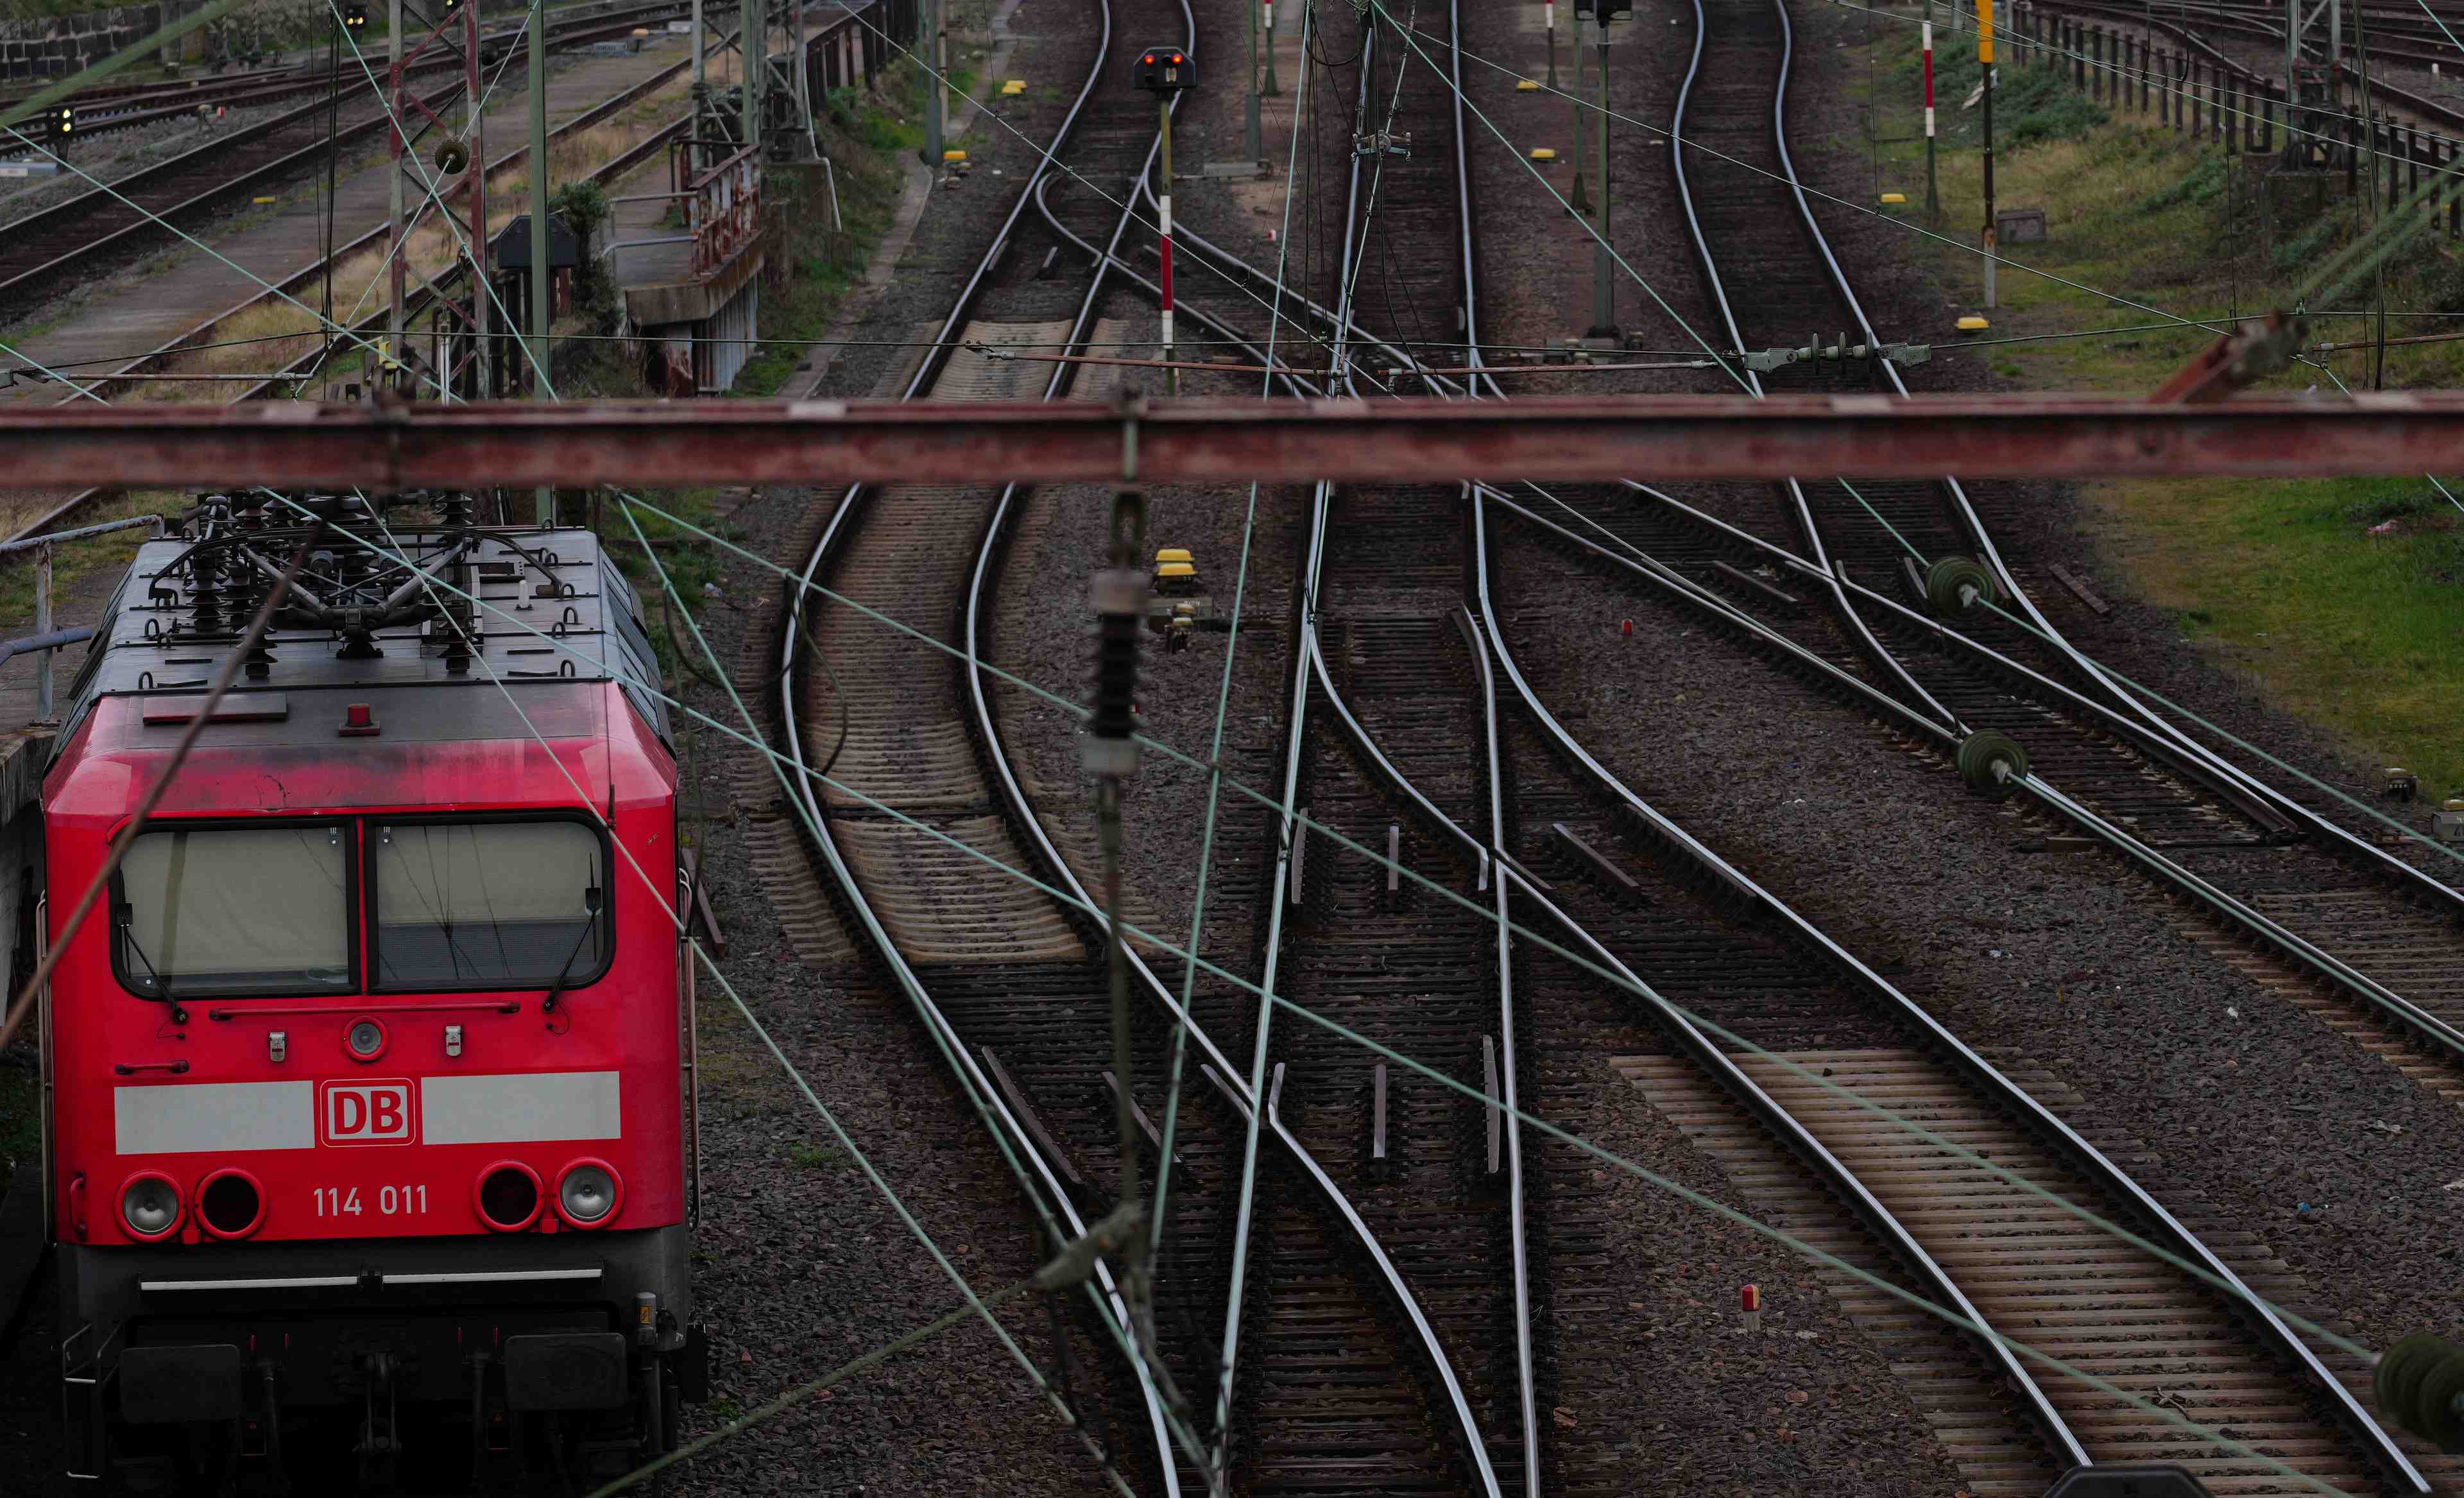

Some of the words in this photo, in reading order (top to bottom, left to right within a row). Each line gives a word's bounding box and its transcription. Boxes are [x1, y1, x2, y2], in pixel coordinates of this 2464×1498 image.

[334, 1090, 403, 1134] DB
[313, 1187, 363, 1216] 114
[379, 1185, 427, 1214] 011
